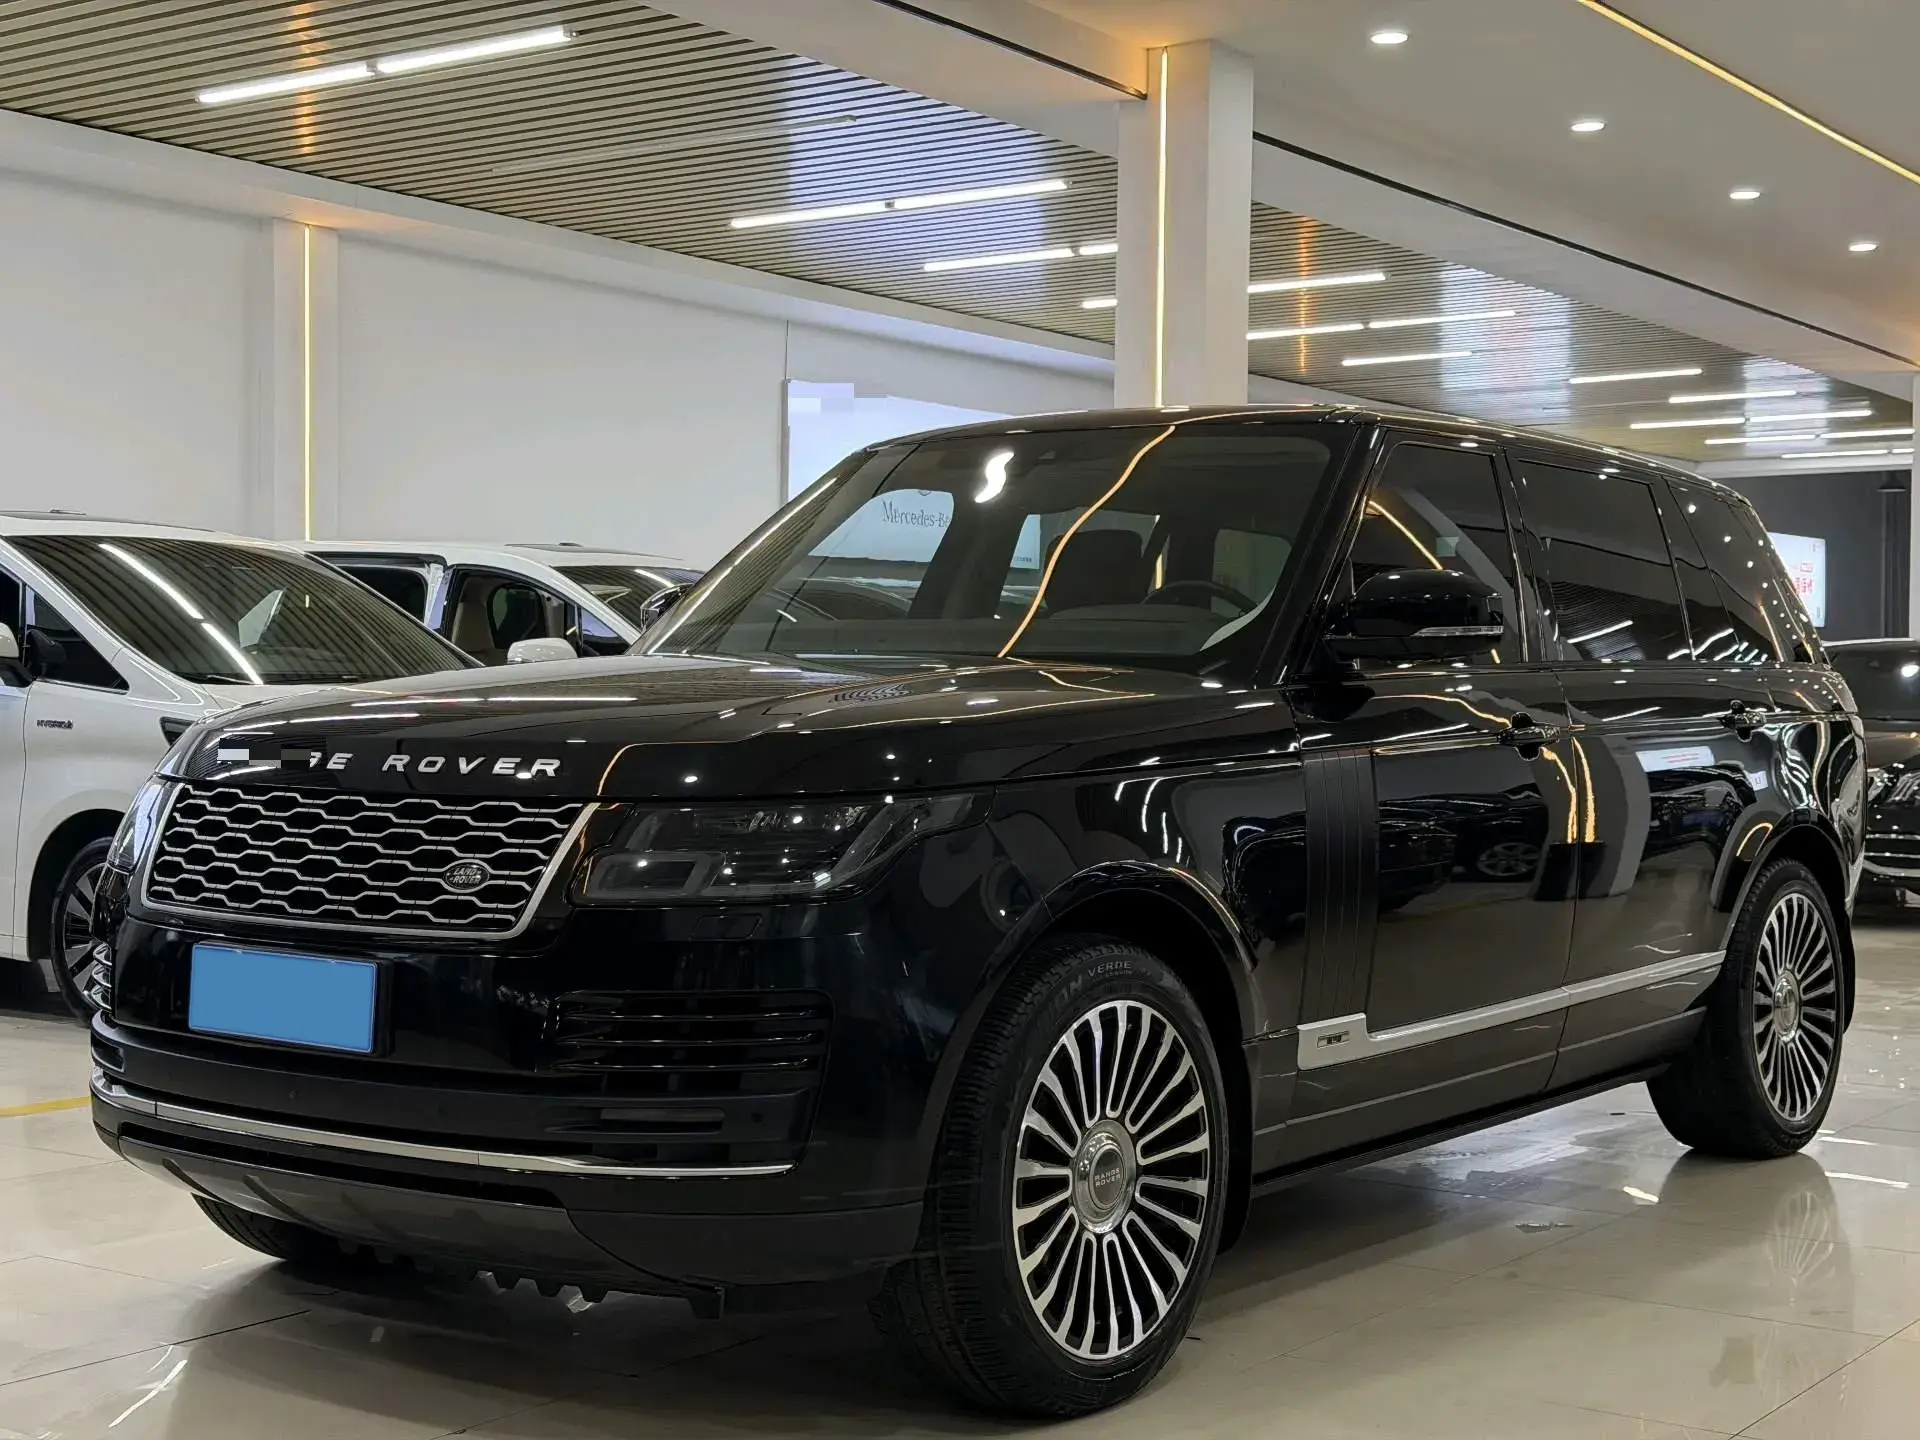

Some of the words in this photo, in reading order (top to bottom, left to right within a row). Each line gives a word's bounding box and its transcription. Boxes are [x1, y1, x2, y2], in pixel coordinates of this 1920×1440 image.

[381, 753, 561, 777] ROVER
[453, 867, 478, 876] LAND
[452, 875, 482, 884] ROVER
[1087, 960, 1132, 977] VERDE
[1095, 1173, 1121, 1188] ROVER
